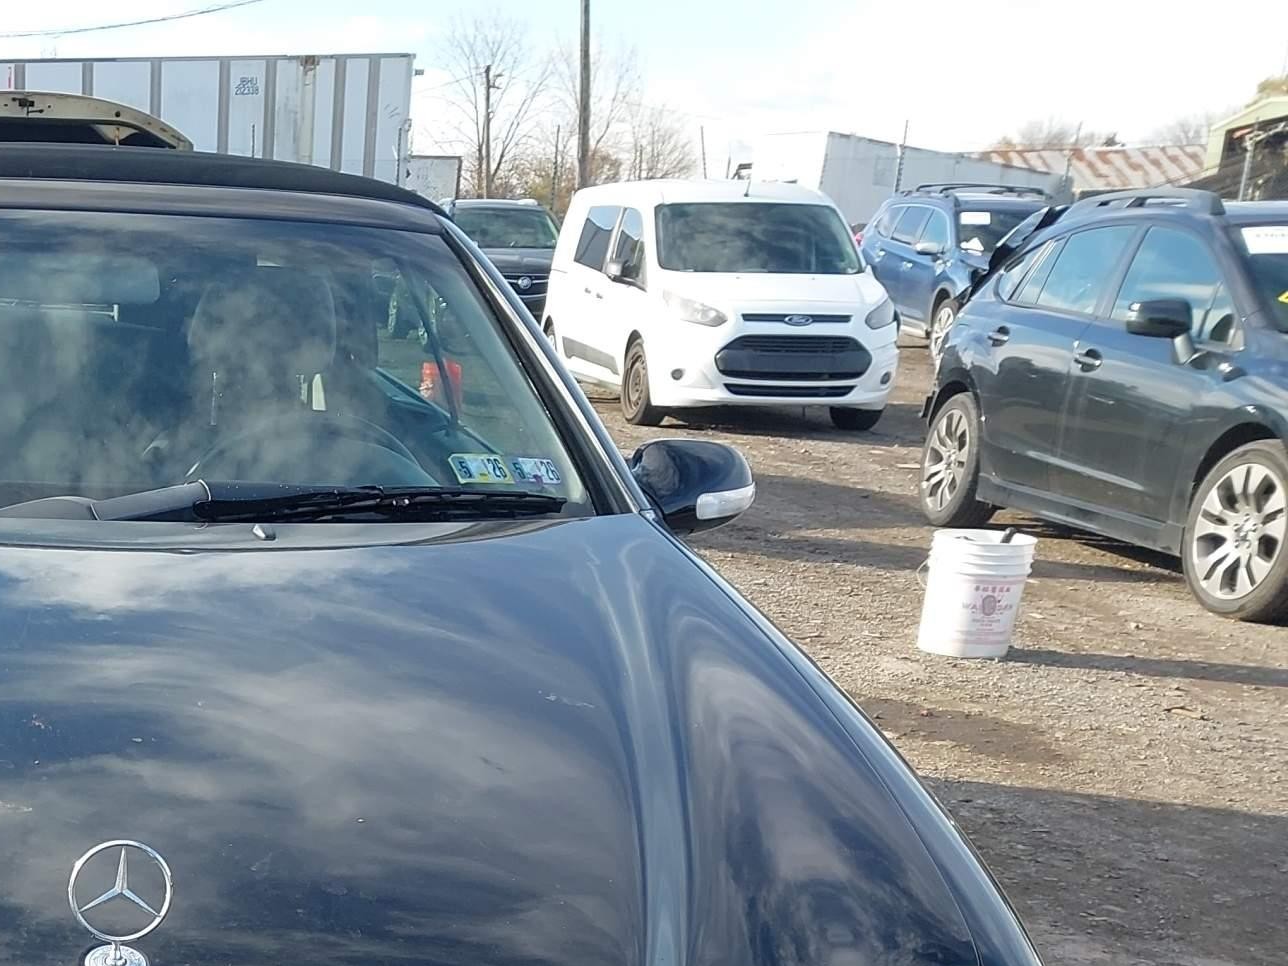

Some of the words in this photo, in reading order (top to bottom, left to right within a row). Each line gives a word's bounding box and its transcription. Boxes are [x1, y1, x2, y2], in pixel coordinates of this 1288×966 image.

[458, 460, 473, 479] 5
[487, 458, 508, 479] 26
[512, 462, 527, 480] 5
